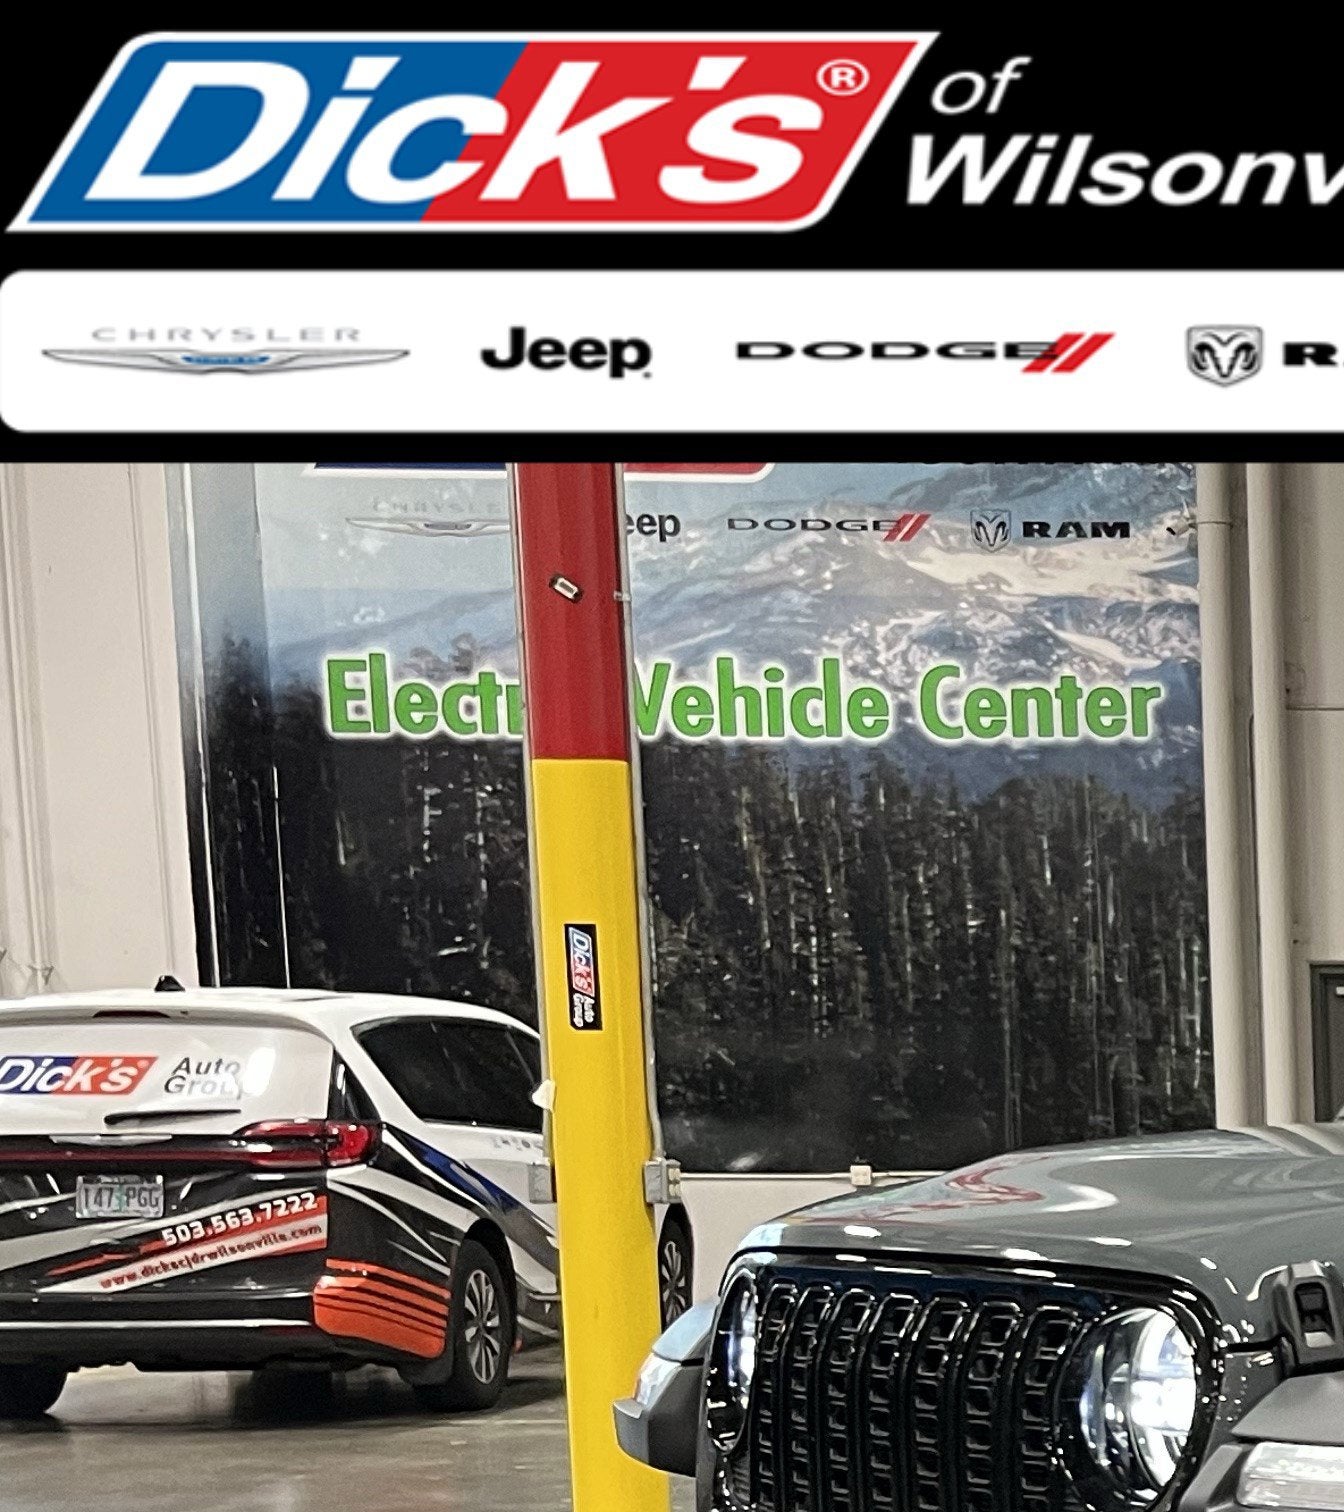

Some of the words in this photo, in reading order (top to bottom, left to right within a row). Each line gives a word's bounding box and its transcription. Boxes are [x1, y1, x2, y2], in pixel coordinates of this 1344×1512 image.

[1022, 520, 1131, 539] RAM
[634, 657, 890, 739] Vehicle
[919, 664, 1163, 740] Center
[171, 1055, 242, 1077] Auto
[161, 1191, 319, 1247] 503.563.7222
